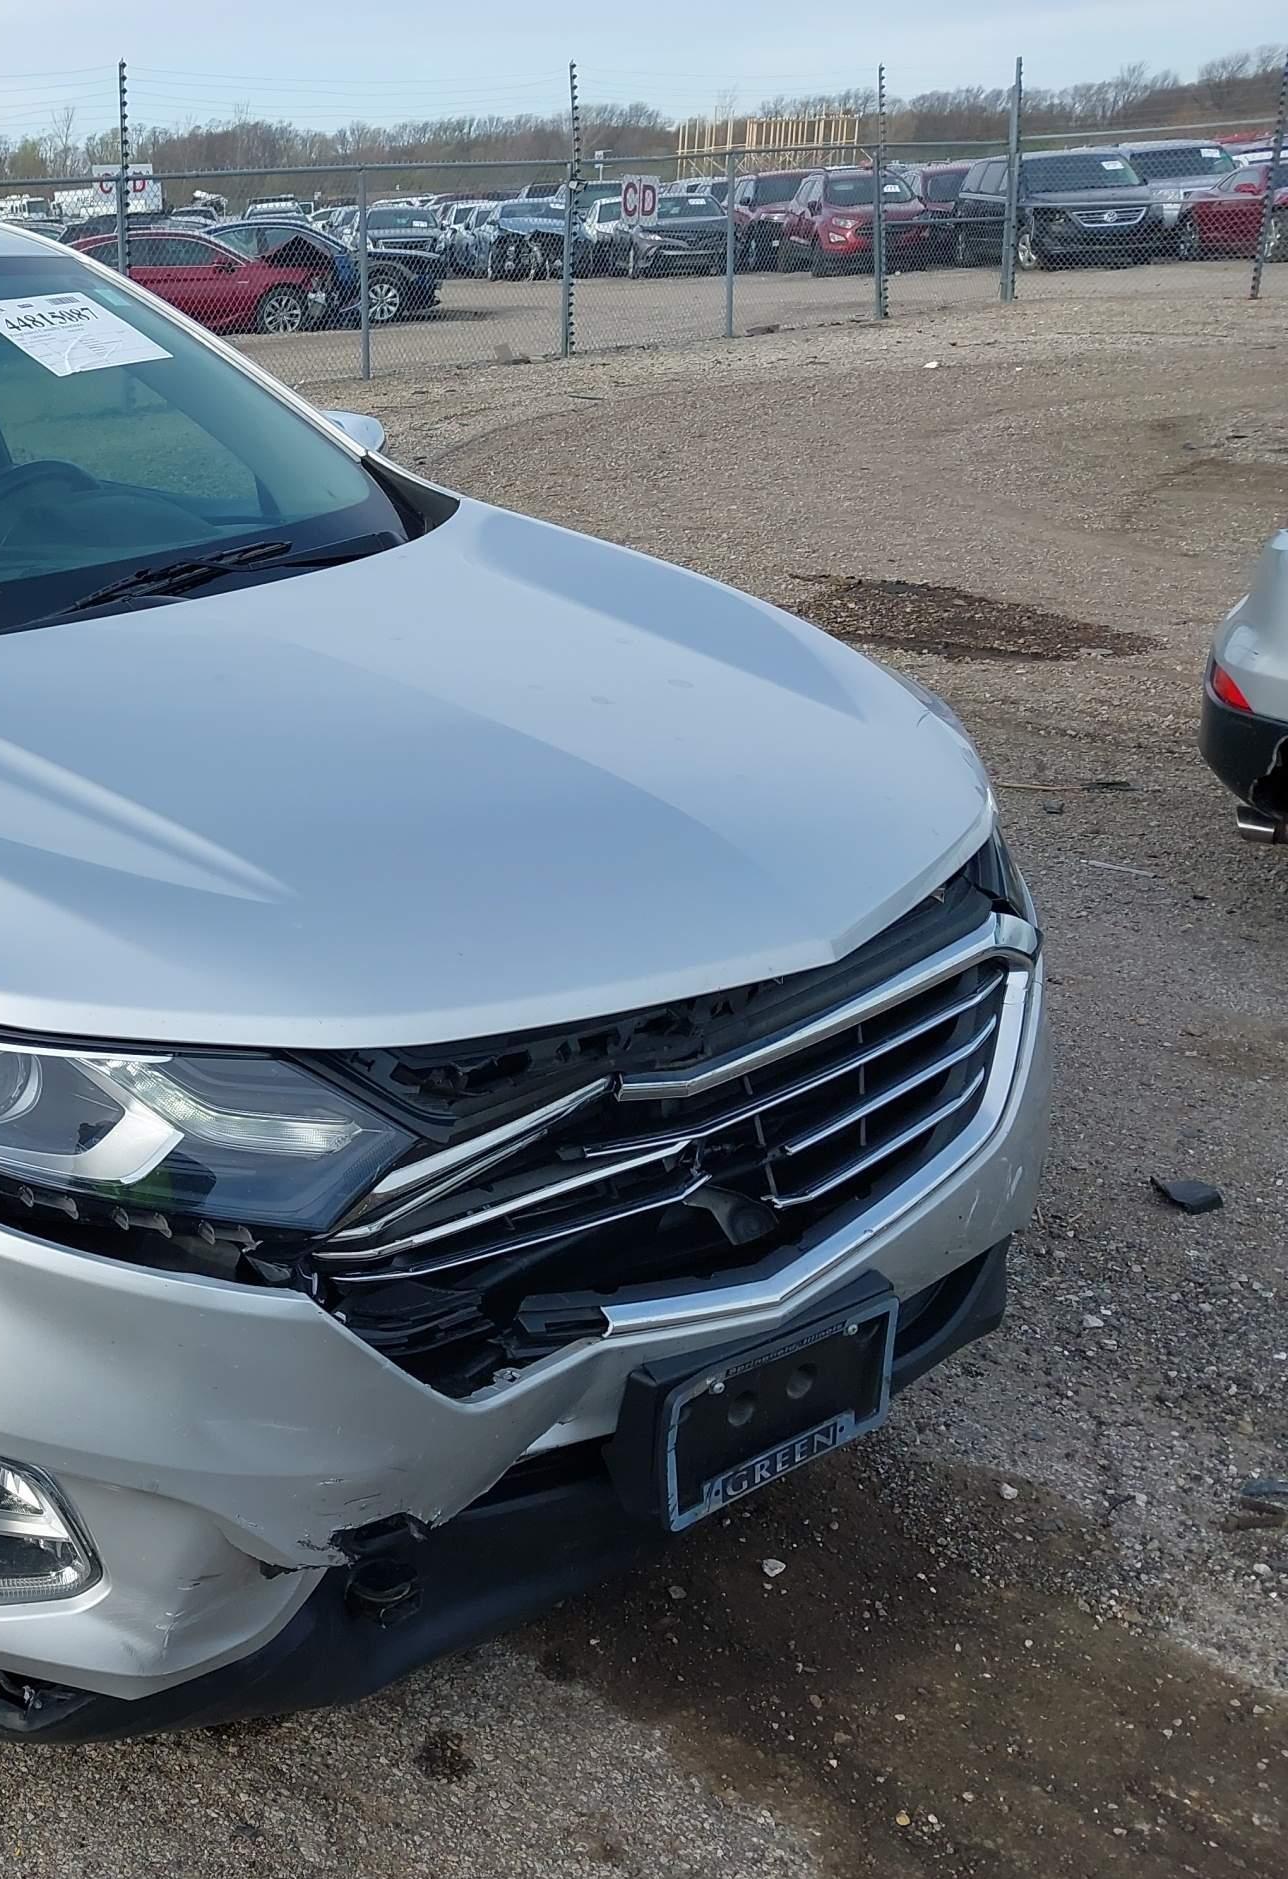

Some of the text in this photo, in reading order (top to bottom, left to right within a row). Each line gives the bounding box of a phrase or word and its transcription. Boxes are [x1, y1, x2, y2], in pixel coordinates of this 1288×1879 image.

[623, 182, 656, 217] CD
[4, 307, 99, 331] 44815087
[726, 1426, 834, 1496] GREEN
